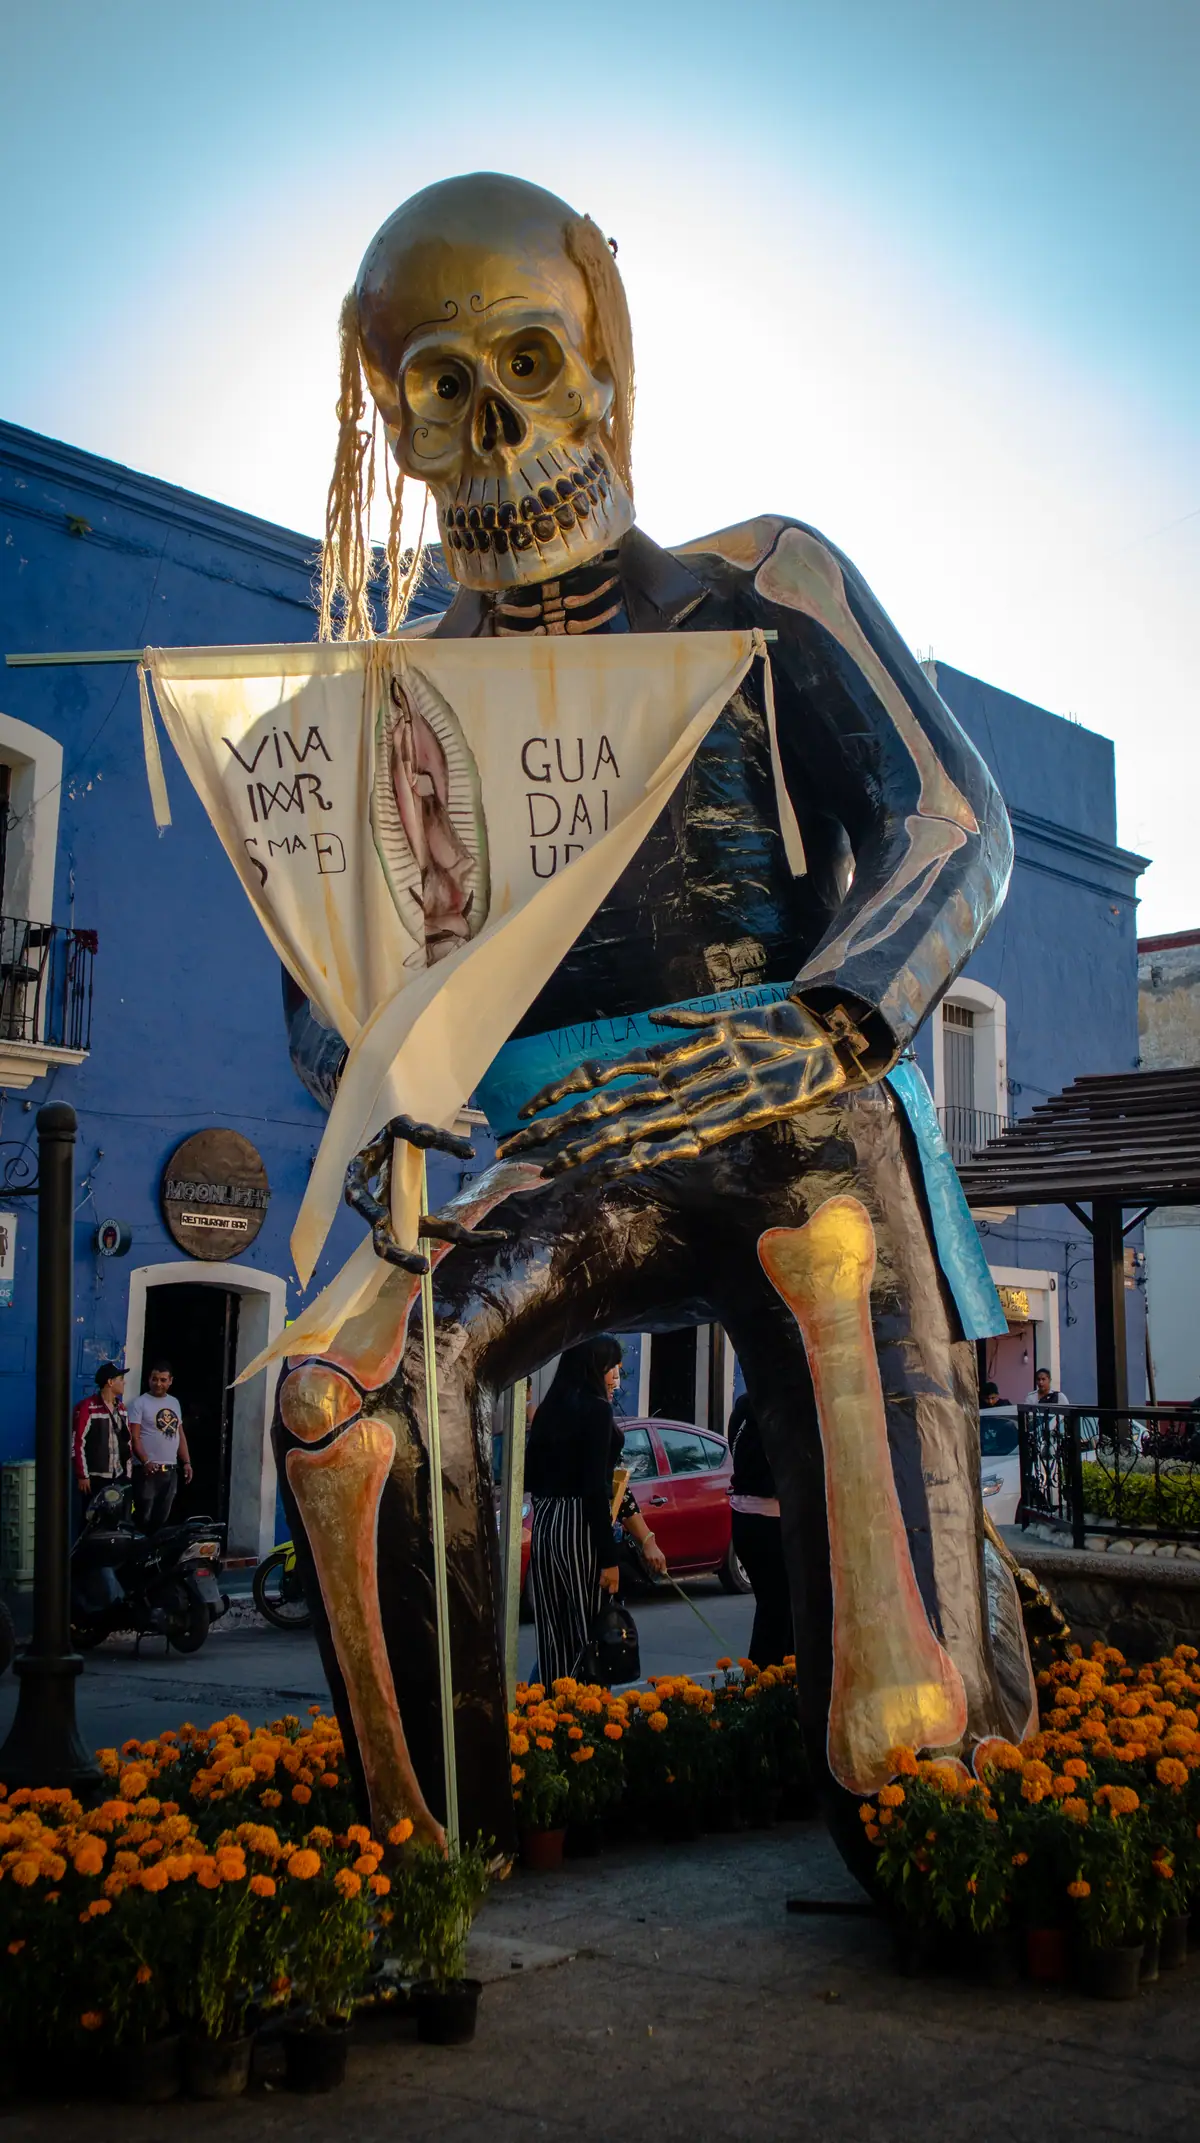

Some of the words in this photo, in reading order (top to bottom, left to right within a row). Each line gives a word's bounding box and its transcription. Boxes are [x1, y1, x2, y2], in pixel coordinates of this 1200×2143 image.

[521, 735, 620, 783] GUA
[548, 1027, 604, 1058] VIVA
[610, 1017, 640, 1043] LA
[165, 1180, 271, 1209] MOONLIGHT
[182, 1215, 230, 1228] RESTAURANT
[231, 1221, 247, 1230] BAR
